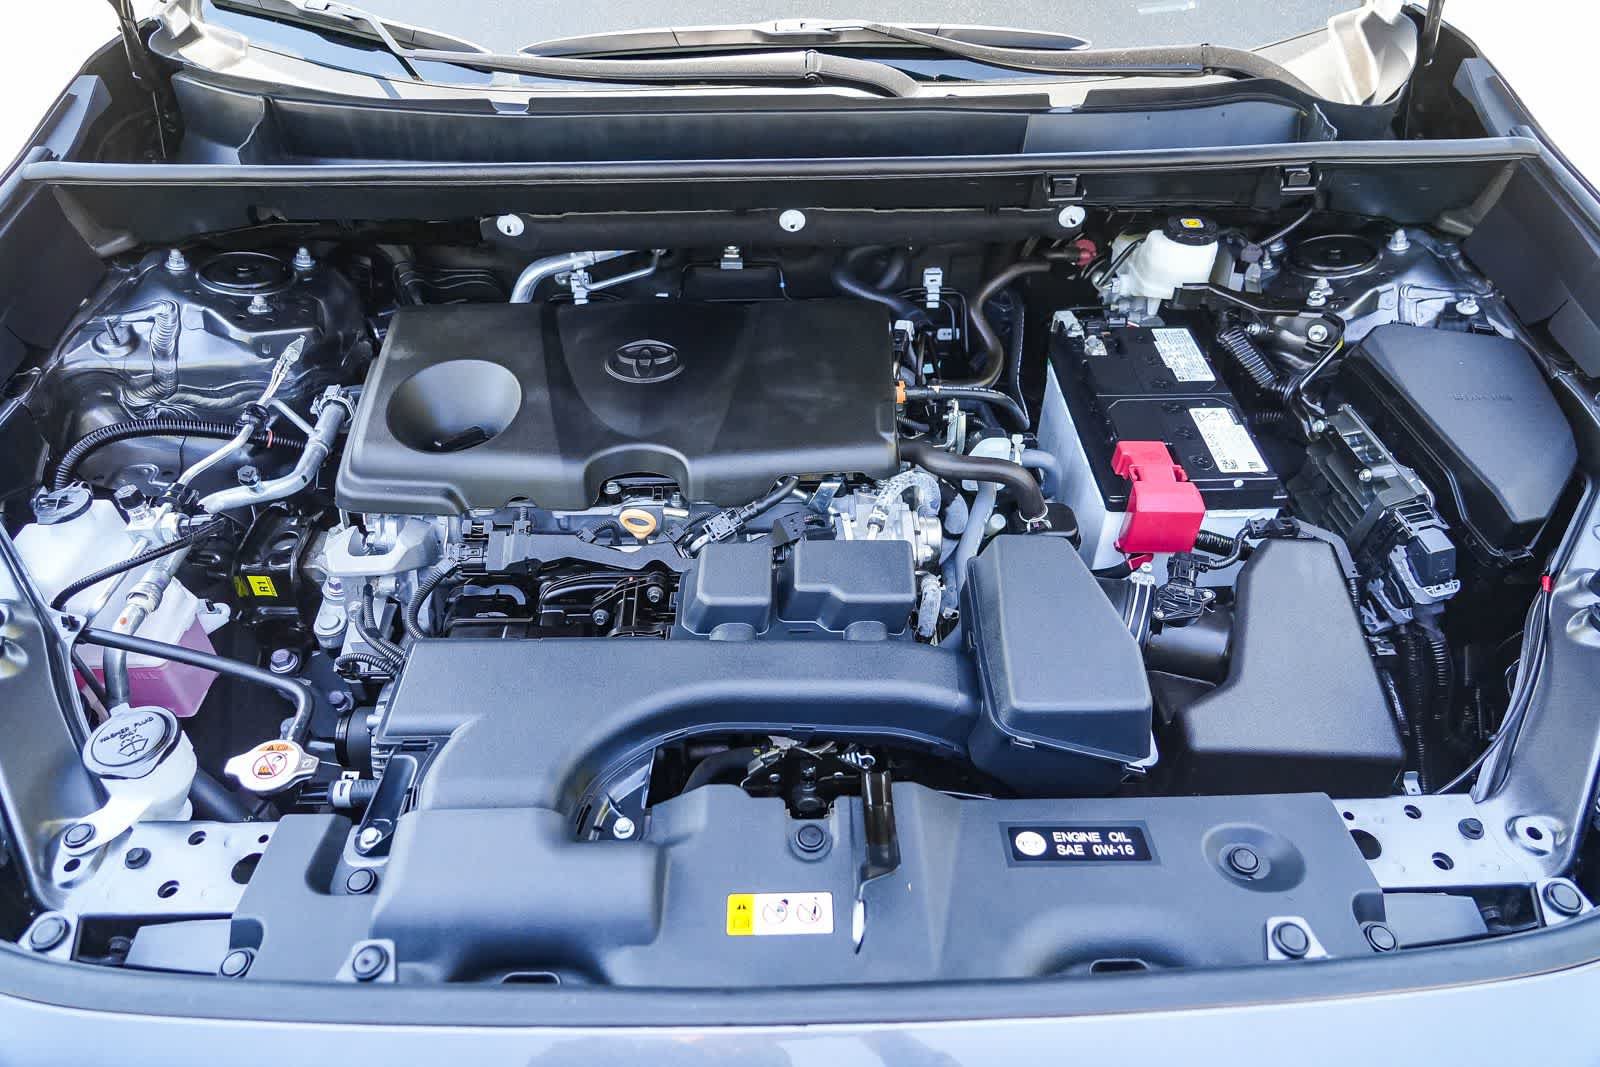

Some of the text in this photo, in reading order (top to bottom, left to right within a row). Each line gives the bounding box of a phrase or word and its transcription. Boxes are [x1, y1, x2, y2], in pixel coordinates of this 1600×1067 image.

[1052, 831, 1102, 843] ENGINE
[1108, 831, 1131, 843] OIL
[1056, 844, 1136, 856] SAE 0W-16
